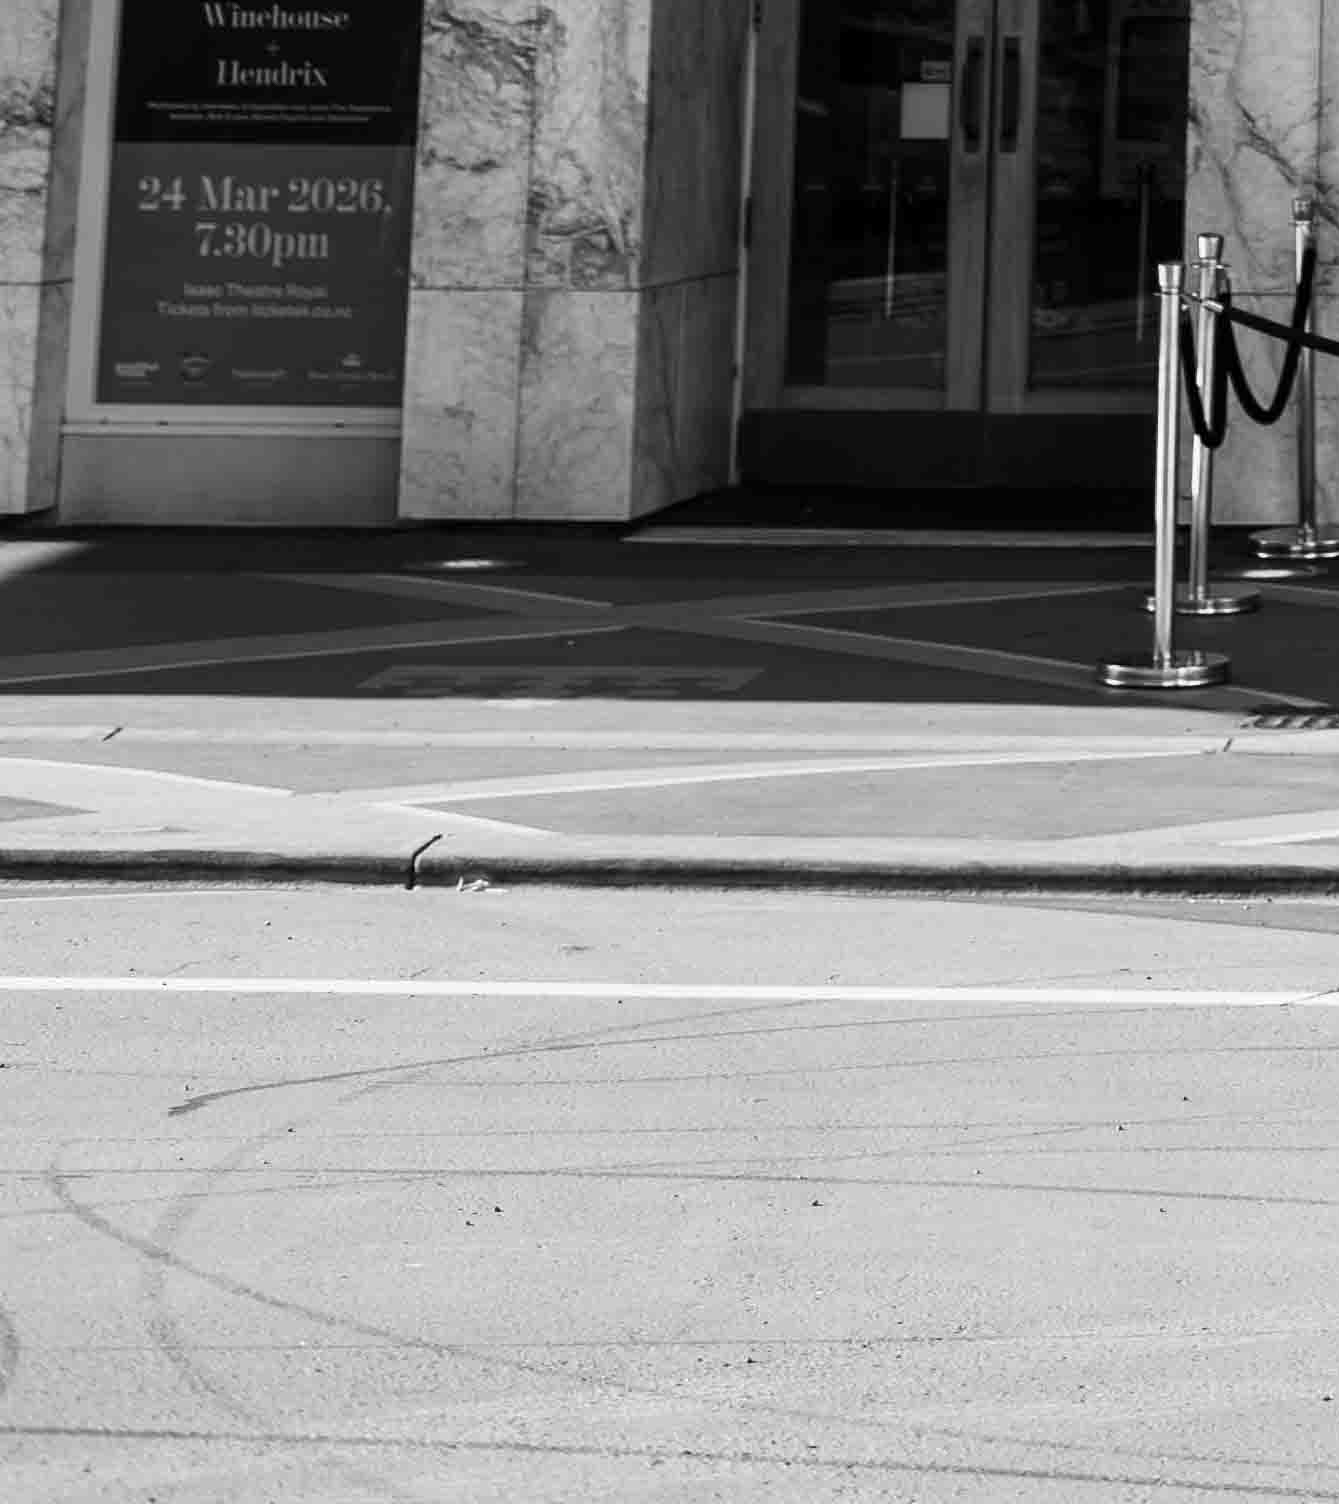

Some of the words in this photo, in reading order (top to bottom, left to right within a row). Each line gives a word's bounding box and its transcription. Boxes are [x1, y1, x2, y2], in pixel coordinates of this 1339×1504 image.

[203, 1, 351, 30] Winehouse
[217, 59, 329, 87] Hendrix
[138, 176, 188, 213] 24
[199, 175, 281, 213] Mar
[195, 221, 329, 269] 7.30pm
